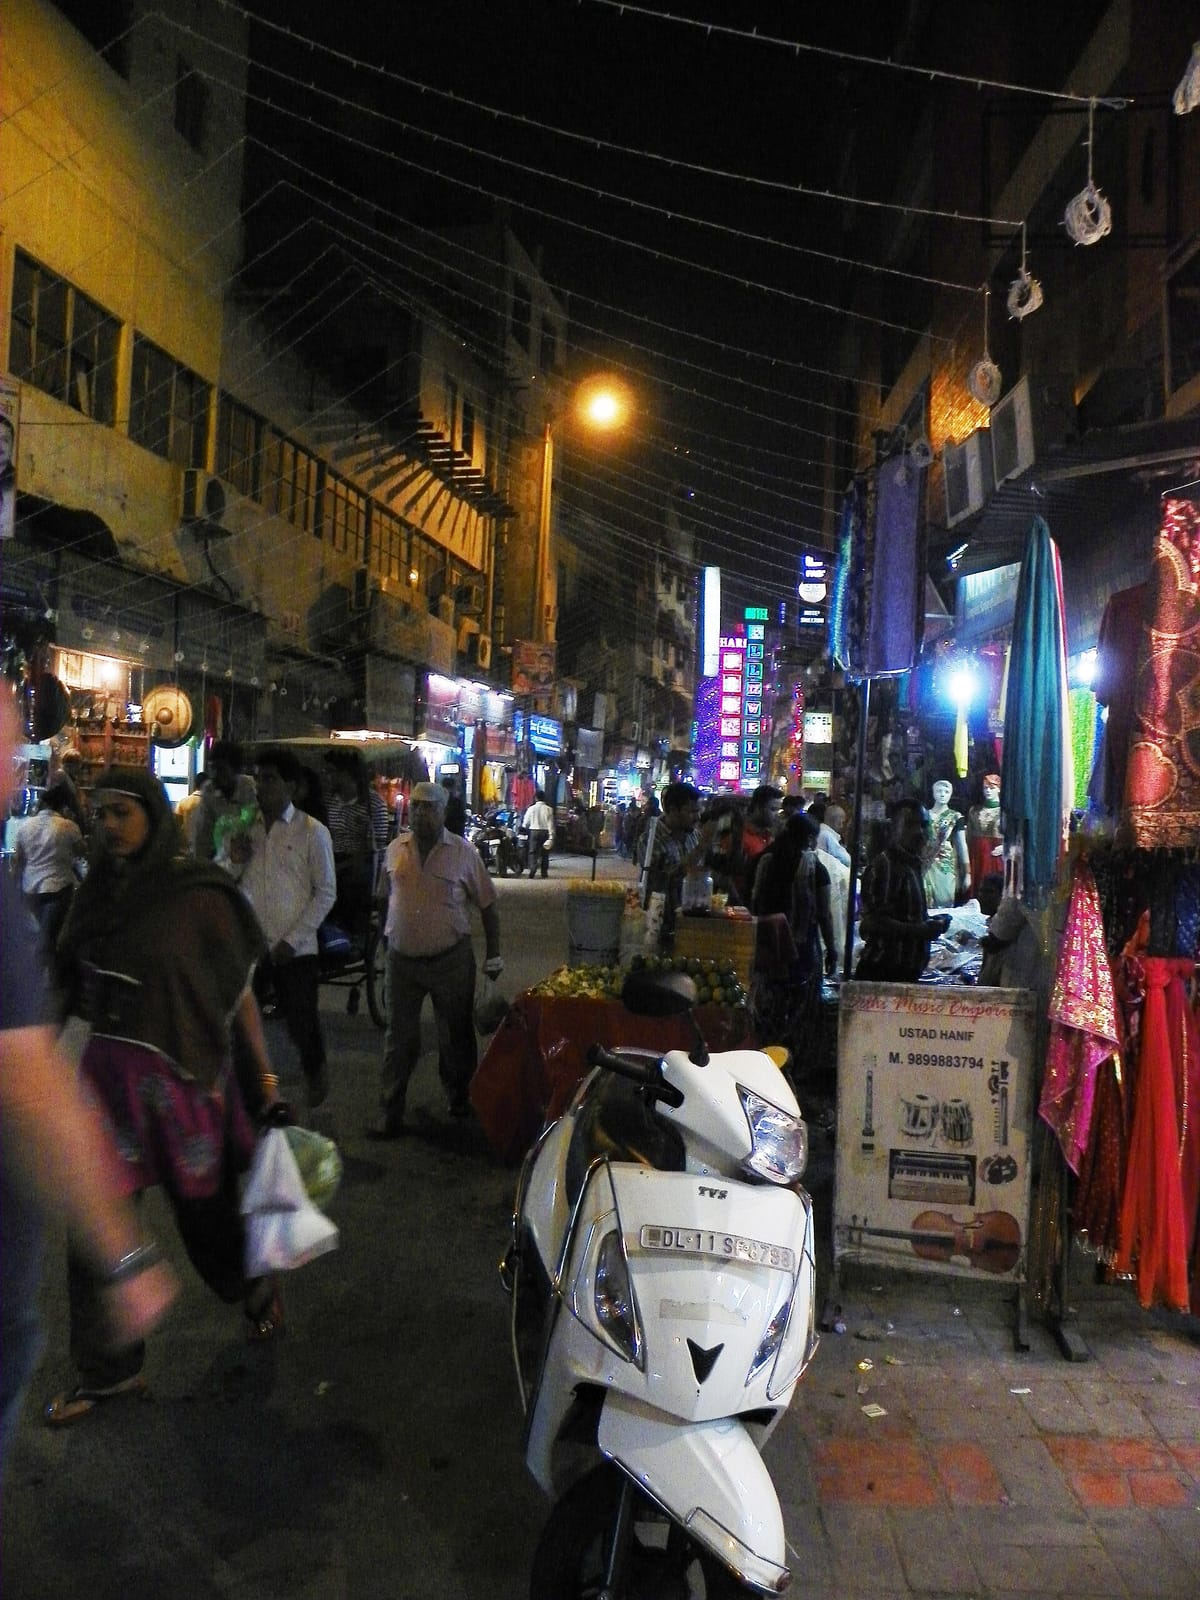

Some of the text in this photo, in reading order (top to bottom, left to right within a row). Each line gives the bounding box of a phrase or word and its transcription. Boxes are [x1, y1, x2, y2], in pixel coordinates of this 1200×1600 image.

[899, 1027, 975, 1042] USTAD HANIF
[889, 1052, 984, 1069] M. 9899883794
[698, 1186, 728, 1200] TVS
